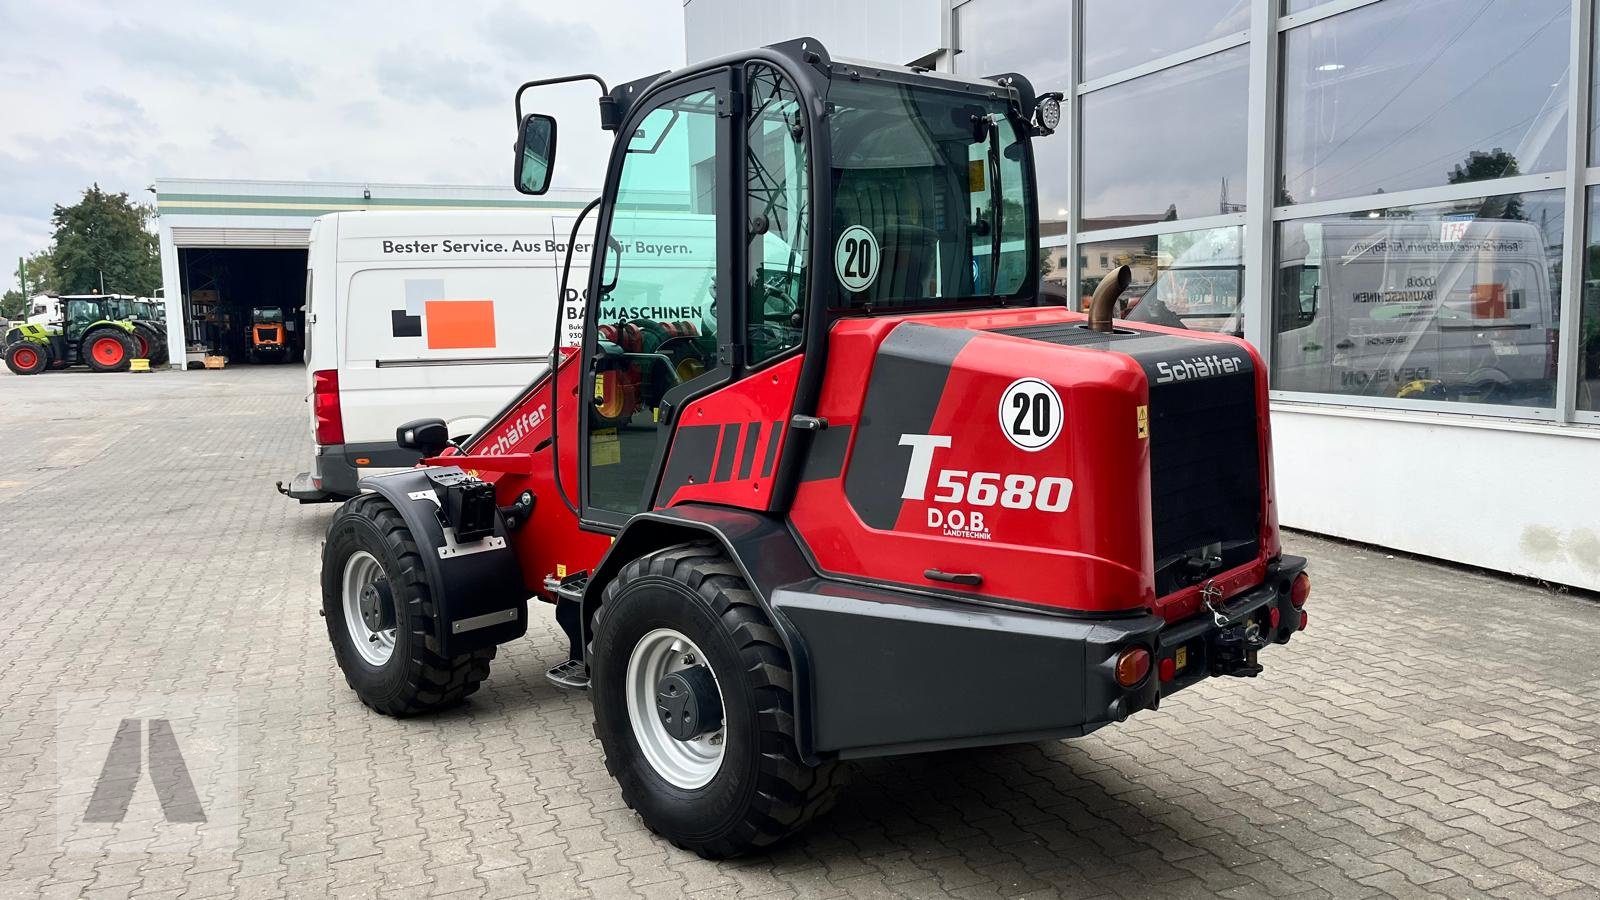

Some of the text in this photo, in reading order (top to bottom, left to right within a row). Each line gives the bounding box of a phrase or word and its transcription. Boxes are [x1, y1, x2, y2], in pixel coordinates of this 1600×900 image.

[383, 240, 438, 254] Bester
[442, 239, 508, 253] Service.
[512, 239, 541, 253] Aus
[545, 239, 595, 256] Baer
[635, 241, 693, 256] Bayern.
[844, 238, 870, 278] 20
[567, 306, 702, 320] BAMASCHINEN
[1156, 355, 1242, 384] Schäffer
[1012, 392, 1051, 438] 20
[927, 507, 989, 533] D.O.B.
[943, 528, 991, 541] LANDTECHNIK
